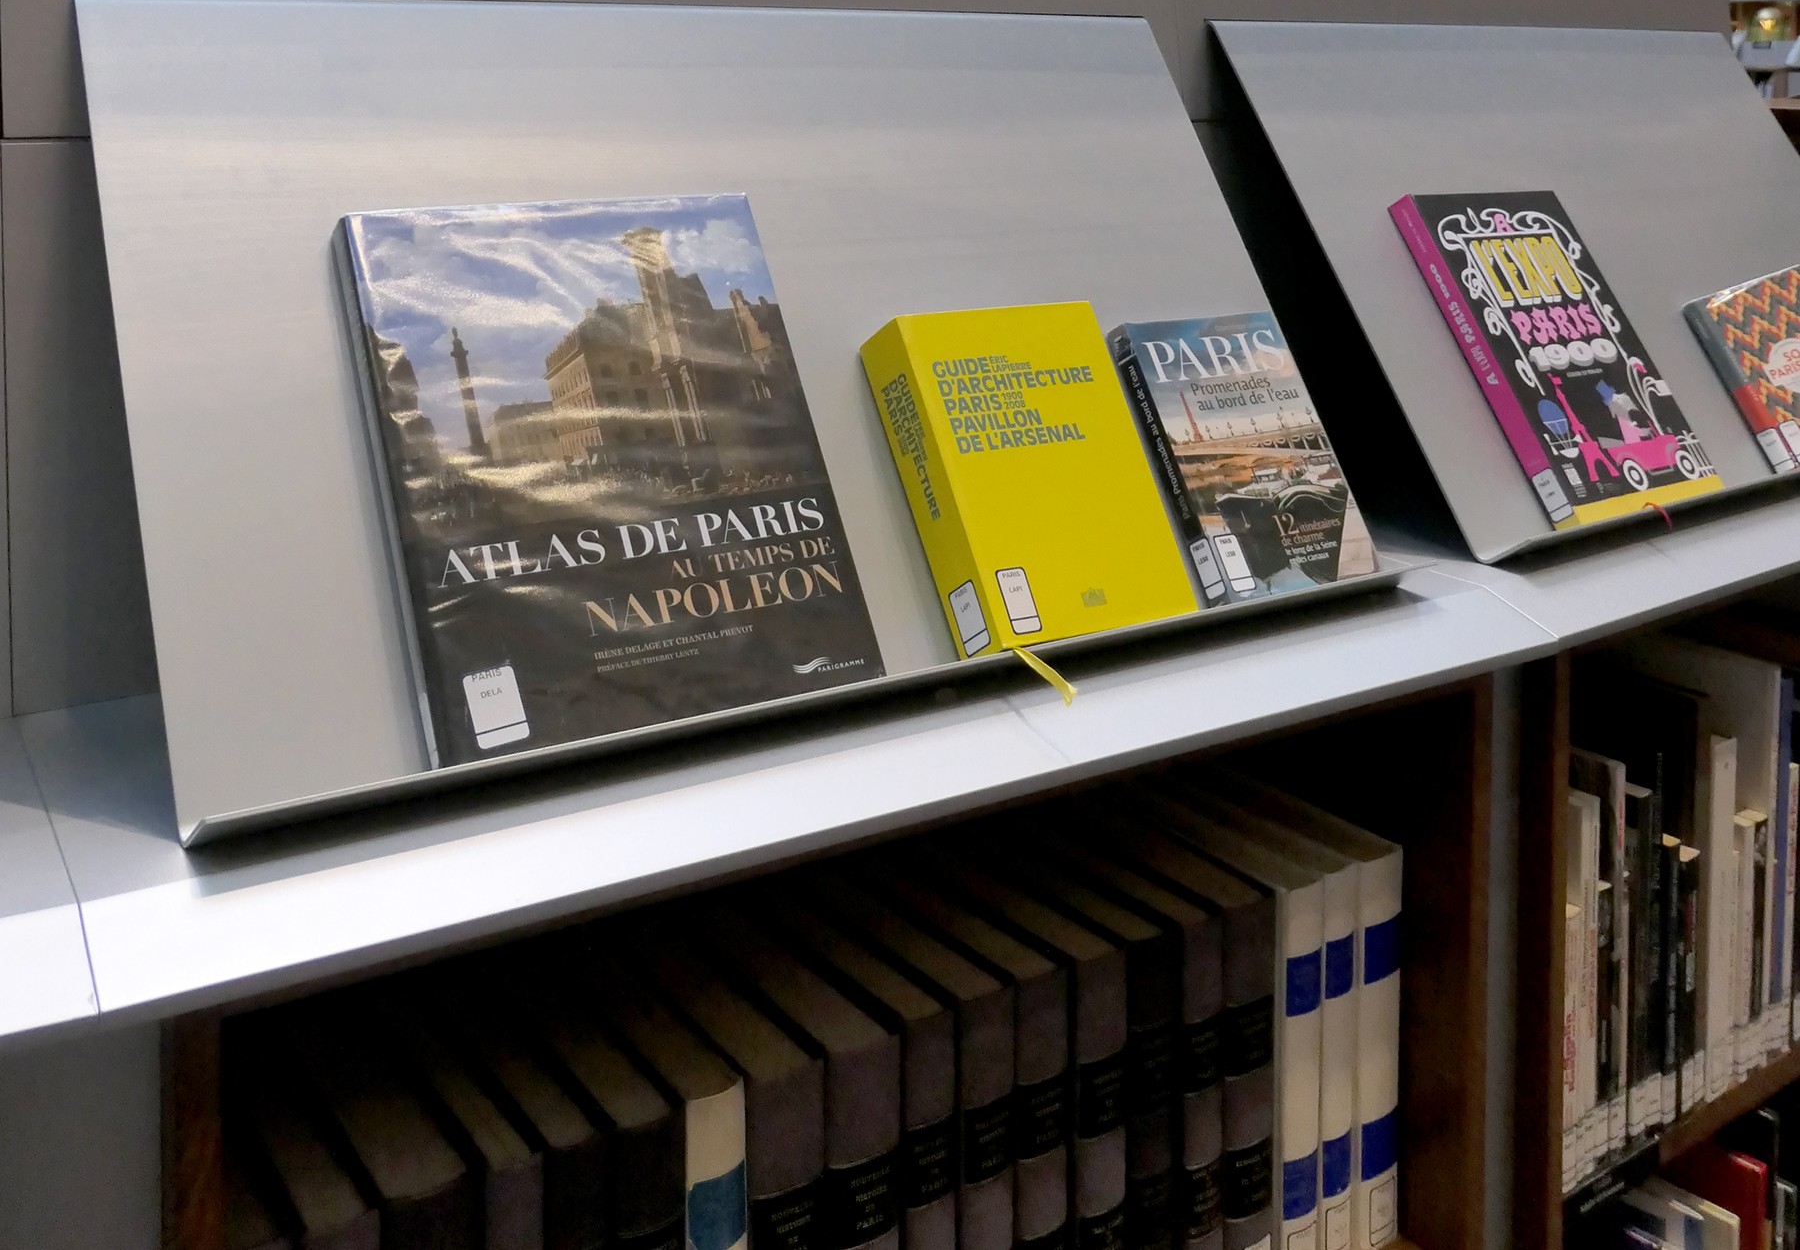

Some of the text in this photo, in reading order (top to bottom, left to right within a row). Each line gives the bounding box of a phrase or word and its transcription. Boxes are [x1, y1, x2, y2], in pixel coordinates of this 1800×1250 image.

[1469, 236, 1583, 308] L'EXPO
[1511, 303, 1602, 345] PARIS
[932, 356, 991, 378] GUIDE
[991, 362, 1032, 373] LAPIERRE
[1141, 329, 1286, 383] PARIS
[1528, 338, 1619, 371] 1900
[937, 366, 1094, 398] D'ARCHITECTURE
[1190, 375, 1271, 397] Promenades
[897, 373, 920, 424] GUIDE
[943, 394, 1003, 416] PARIS
[1001, 391, 1023, 401] 1900
[1003, 400, 1027, 410] 2008
[1197, 388, 1300, 411] au bord de l'eau
[881, 386, 905, 437] PARIS
[949, 408, 1042, 435] PAVILLON
[888, 378, 941, 521] D'ARCHITECTURE
[955, 436, 984, 455] DE
[986, 423, 1086, 451] L'ARSENAL
[1128, 365, 1190, 520] Paris Promenades au bord de l'eau
[1272, 512, 1300, 537] 12
[438, 498, 825, 588] ATLAS DE PARIS
[1281, 532, 1325, 547] de charme
[670, 536, 836, 581] AU TEMPS DE
[1002, 571, 1020, 579] PARIS
[581, 561, 844, 637] NAPOLEON
[594, 646, 624, 660] IRÈNE
[625, 641, 661, 655] DELAGE
[662, 638, 674, 648] ET
[676, 631, 719, 645] CHANTAL
[597, 661, 630, 673] PRÉFACE
[631, 659, 641, 668] DE
[675, 648, 699, 659] LENTZ
[817, 658, 865, 673] PARIGRAMME
[471, 668, 502, 682] PARIS
[480, 687, 503, 699] DELA
